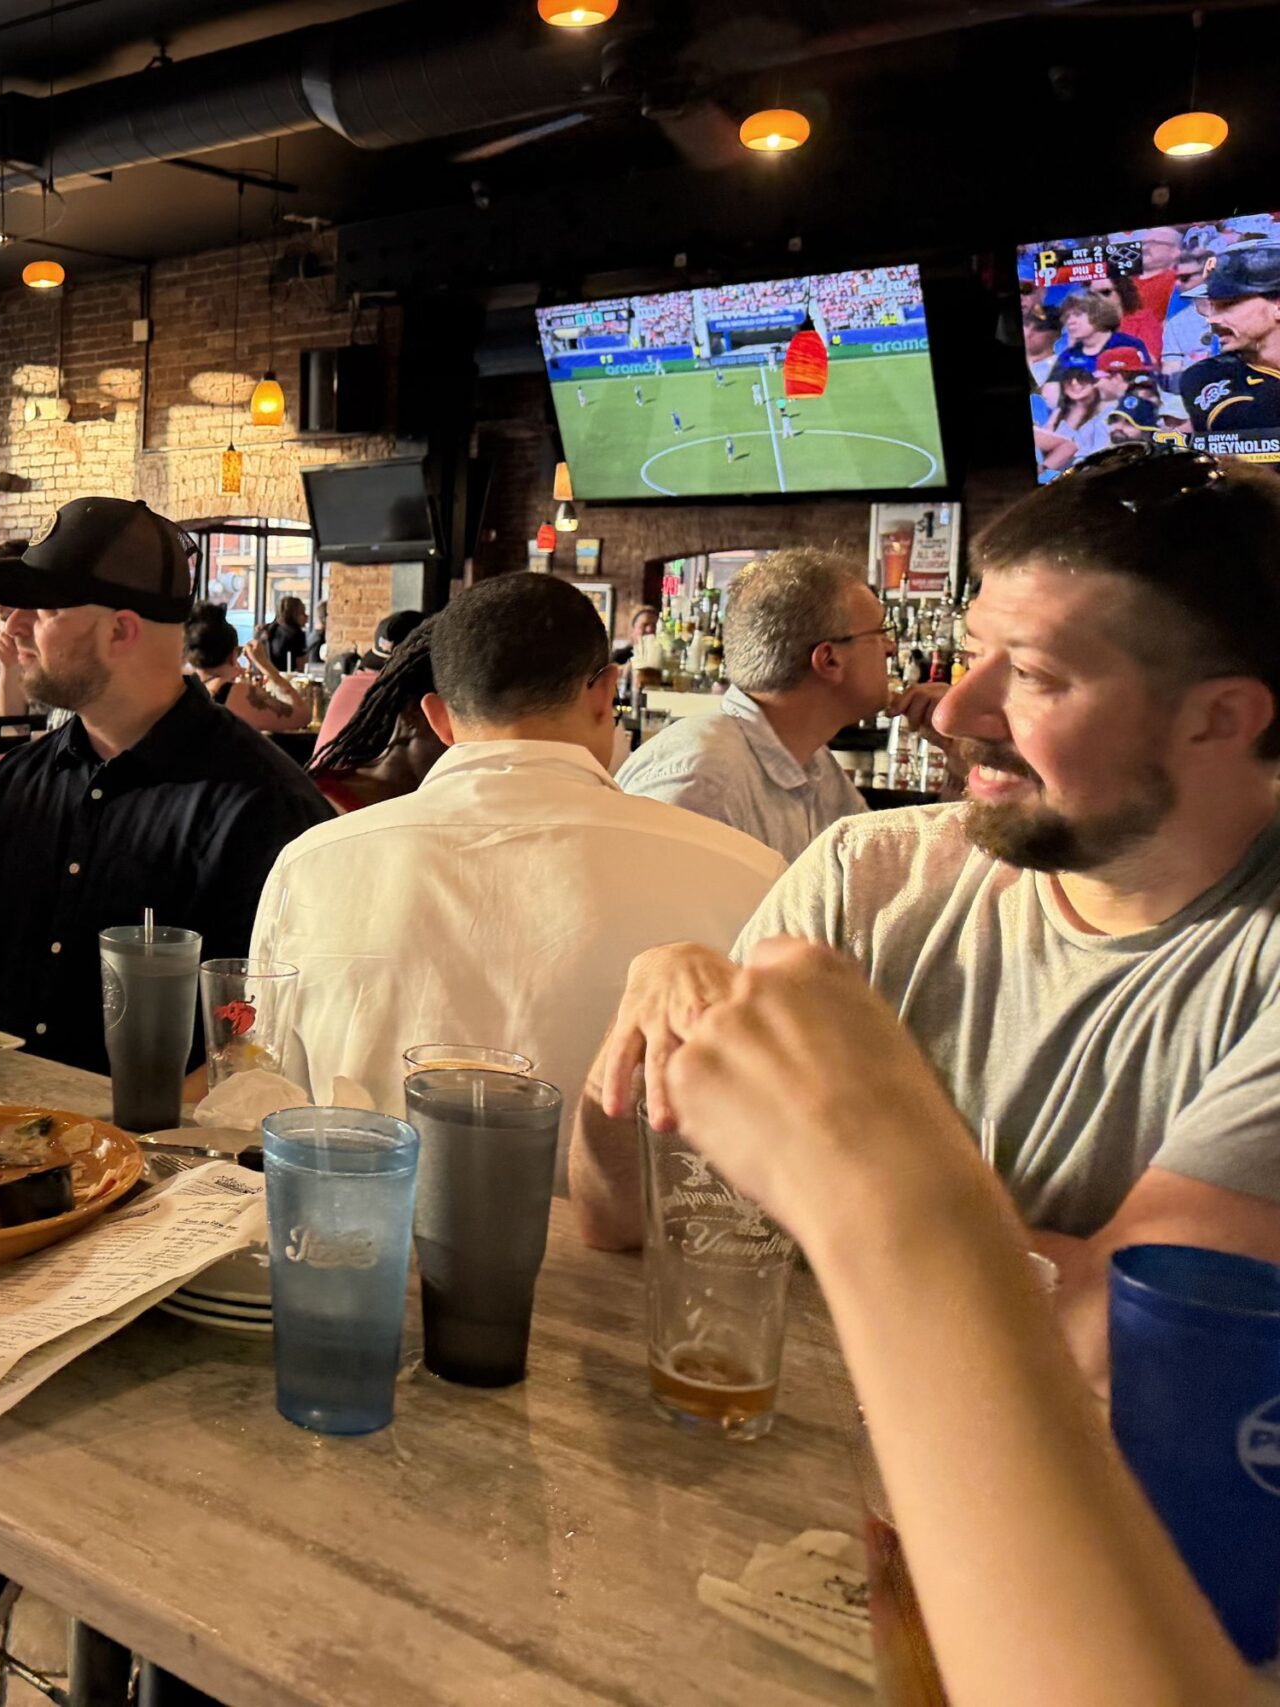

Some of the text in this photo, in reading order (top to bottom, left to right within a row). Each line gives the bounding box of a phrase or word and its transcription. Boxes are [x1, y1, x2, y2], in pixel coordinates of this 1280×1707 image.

[1072, 248, 1089, 259] PIT
[1093, 246, 1103, 257] 2
[1094, 263, 1105, 274] 8
[1207, 433, 1239, 443] BRYAN
[1193, 442, 1205, 451] 10
[1208, 439, 1280, 455] REYNOLDS
